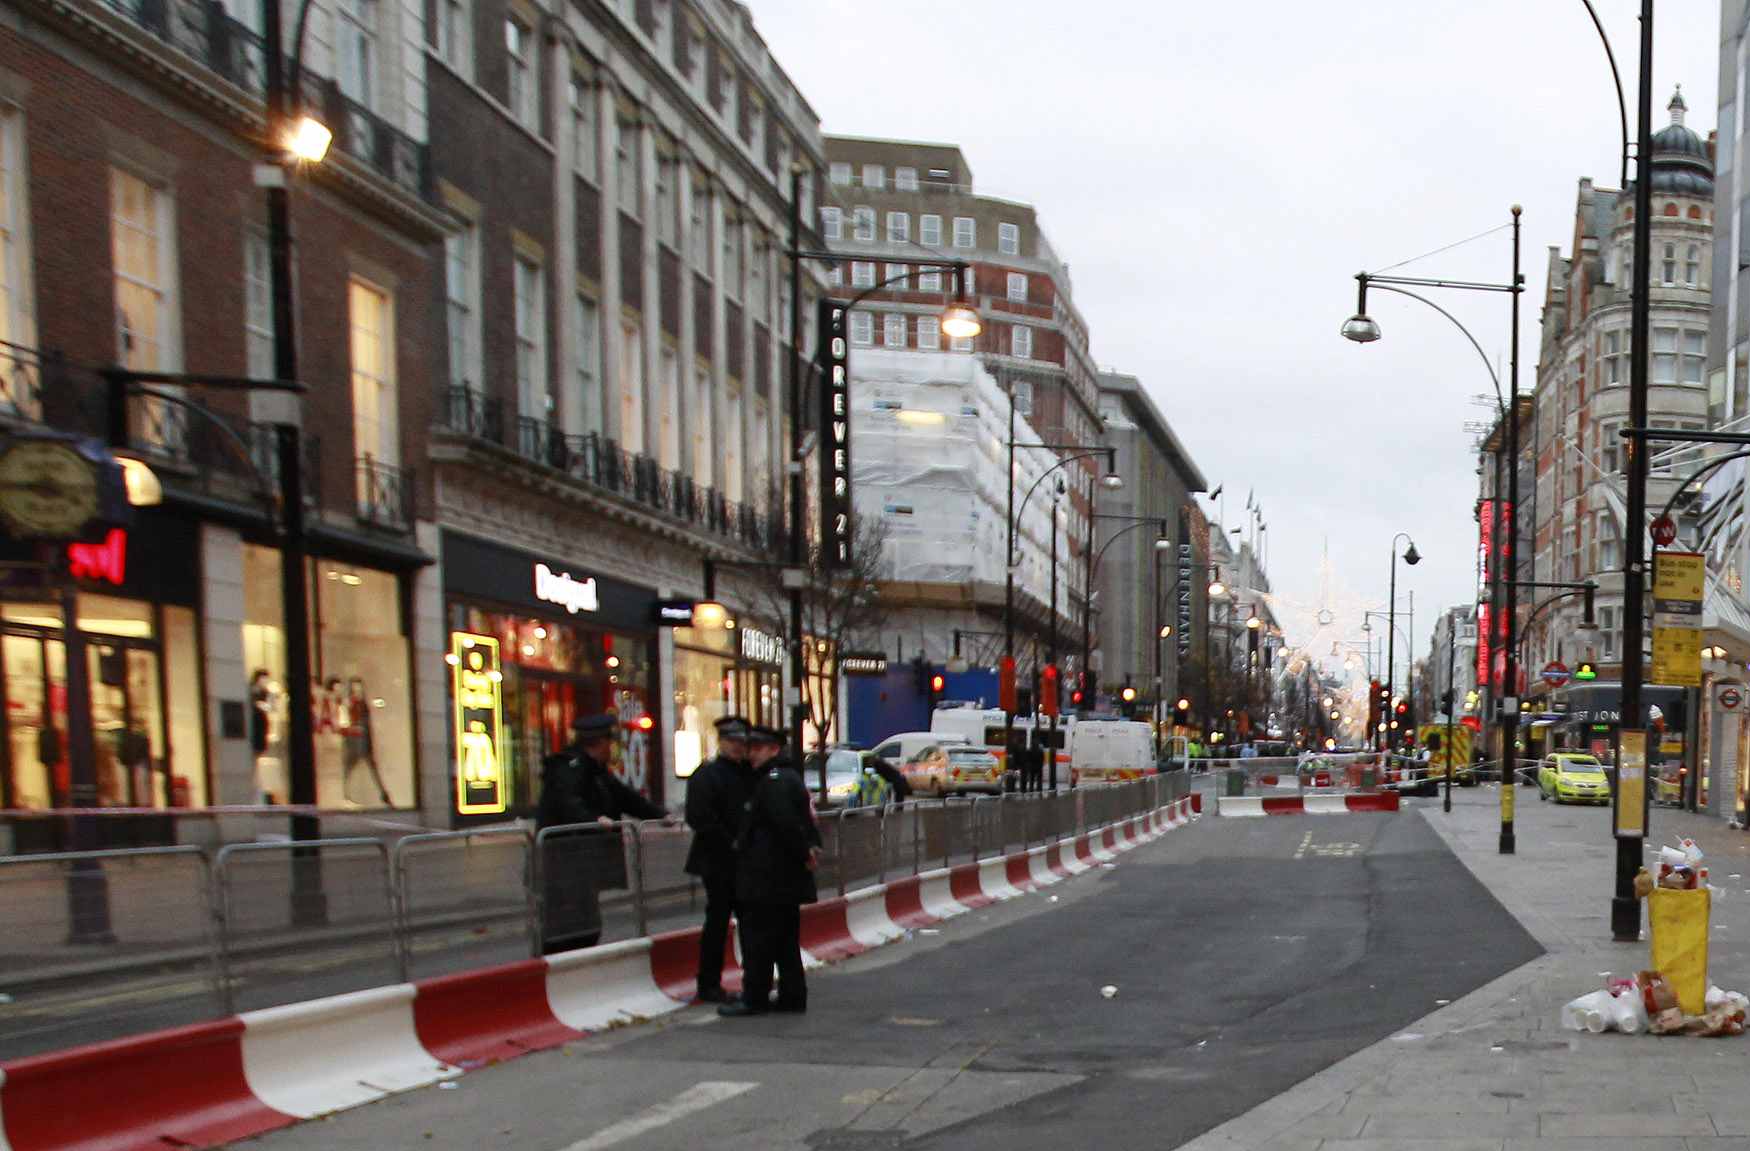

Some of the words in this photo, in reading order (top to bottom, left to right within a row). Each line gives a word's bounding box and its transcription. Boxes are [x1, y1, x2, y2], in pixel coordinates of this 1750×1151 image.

[831, 308, 847, 498] FOREVER
[835, 513, 848, 562] 21
[1178, 543, 1192, 655] DEBENHAMS
[742, 627, 775, 664] FOREVER
